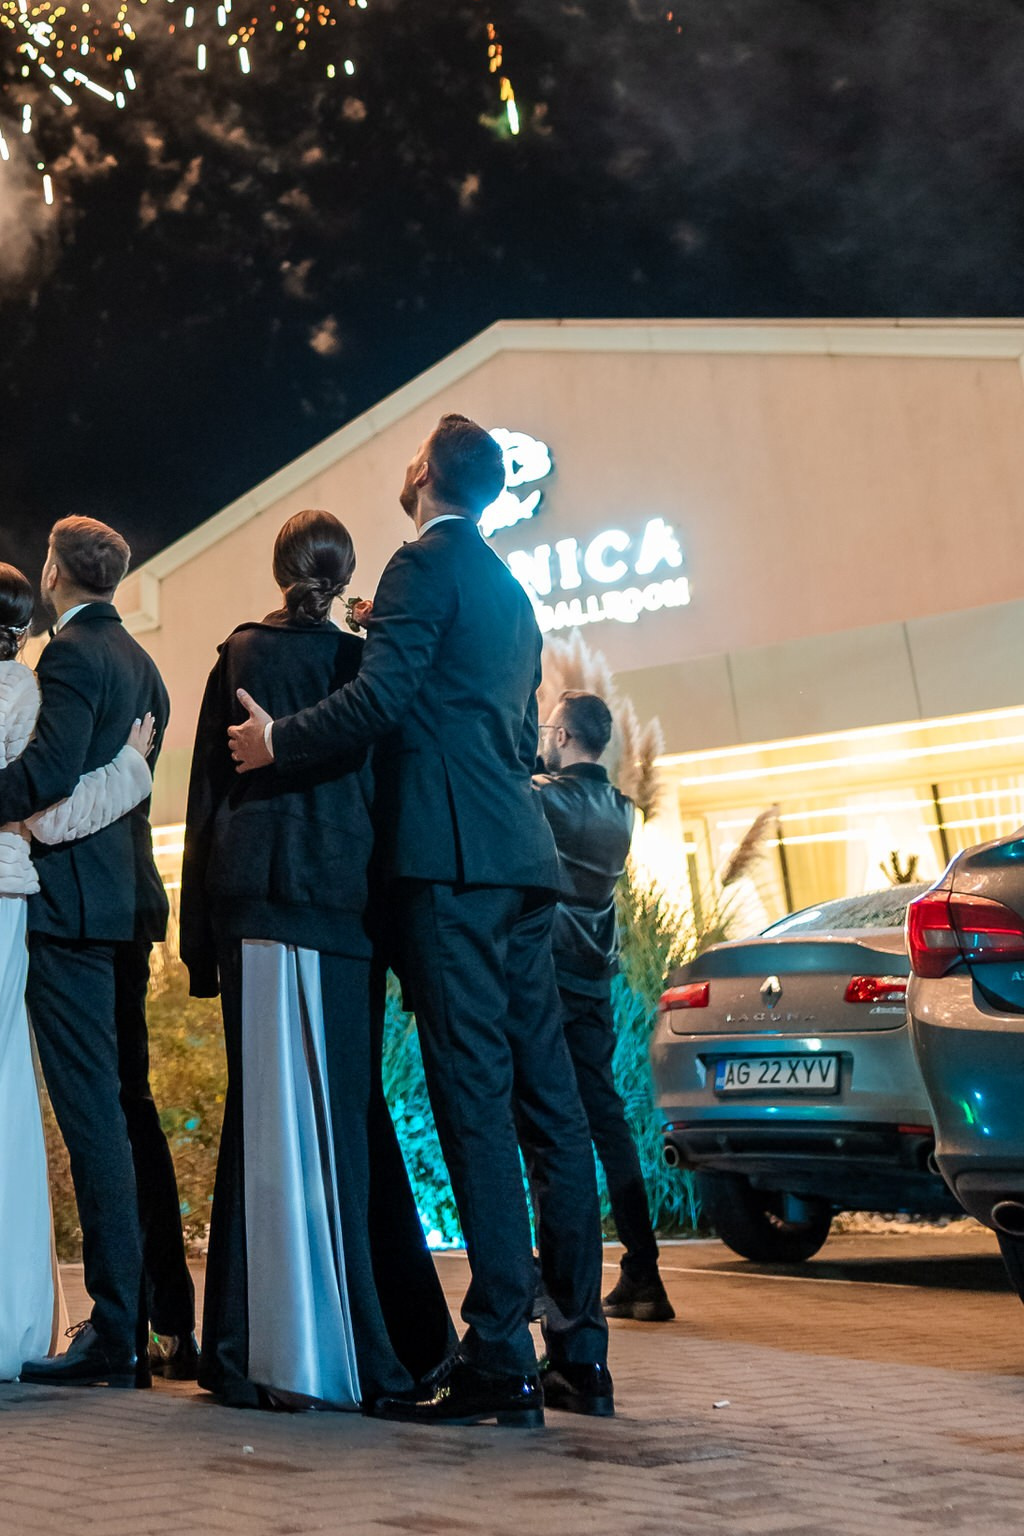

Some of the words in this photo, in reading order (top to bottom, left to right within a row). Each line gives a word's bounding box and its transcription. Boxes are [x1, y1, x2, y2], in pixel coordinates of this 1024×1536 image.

[725, 1062, 751, 1086] AG
[758, 1061, 782, 1084] 22
[786, 1059, 832, 1084] XYV
